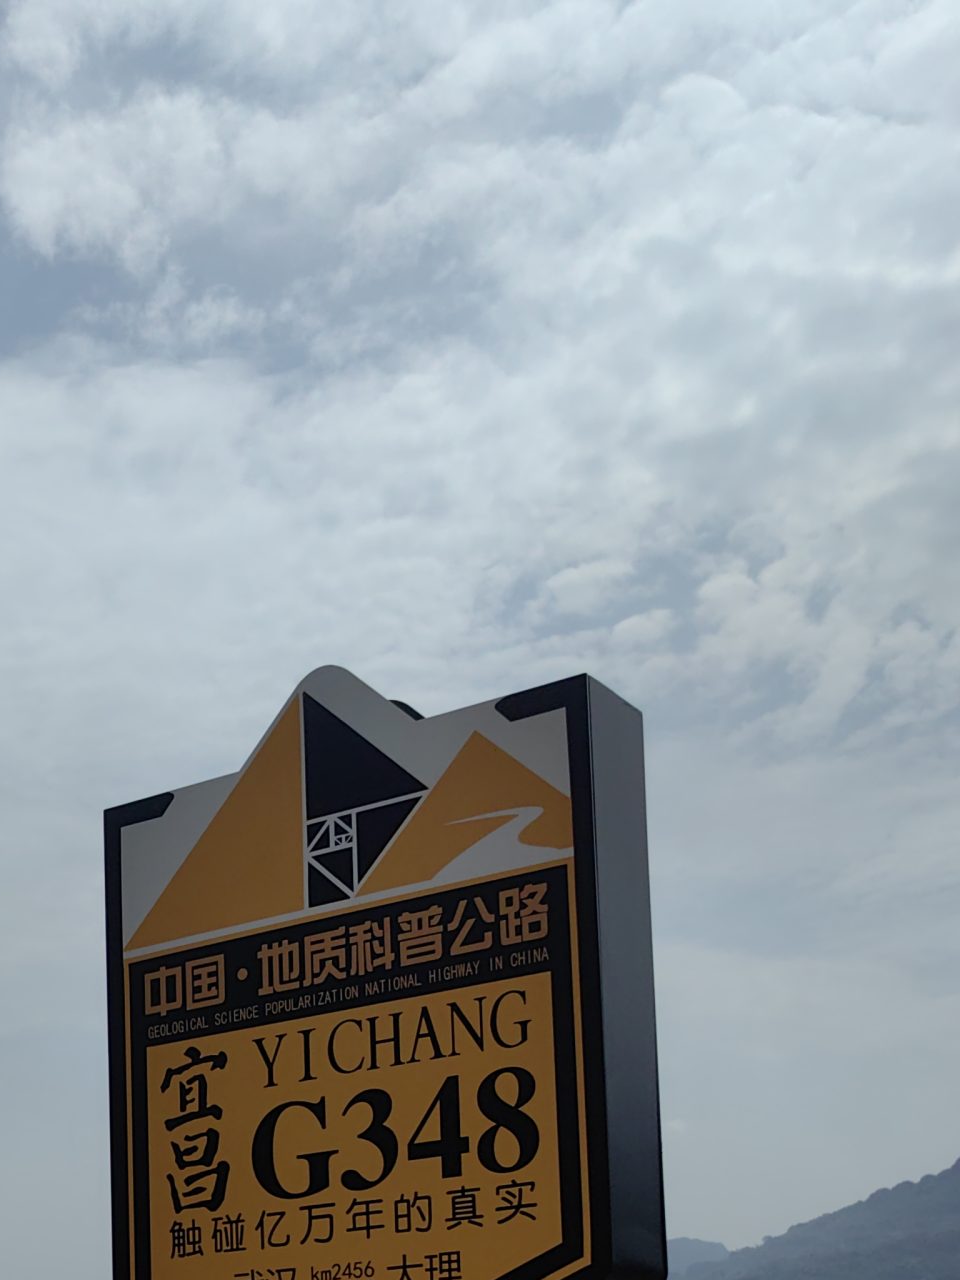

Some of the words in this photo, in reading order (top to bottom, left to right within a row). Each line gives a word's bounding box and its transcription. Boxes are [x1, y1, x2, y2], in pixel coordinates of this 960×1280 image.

[147, 1019, 209, 1040] GEOLOGICAL
[214, 1004, 259, 1026] SCIENCE
[265, 986, 359, 1016] POPULARIZATION
[365, 973, 422, 994] NATIONAL
[428, 960, 481, 984] HIGHWAY
[490, 955, 503, 971] IN
[510, 947, 550, 968] CHINA
[251, 989, 533, 1089] YICHANG
[160, 1046, 231, 1214] 宜昌
[250, 1066, 540, 1200] G348
[169, 1179, 538, 1260] 触碰亿万年的真实
